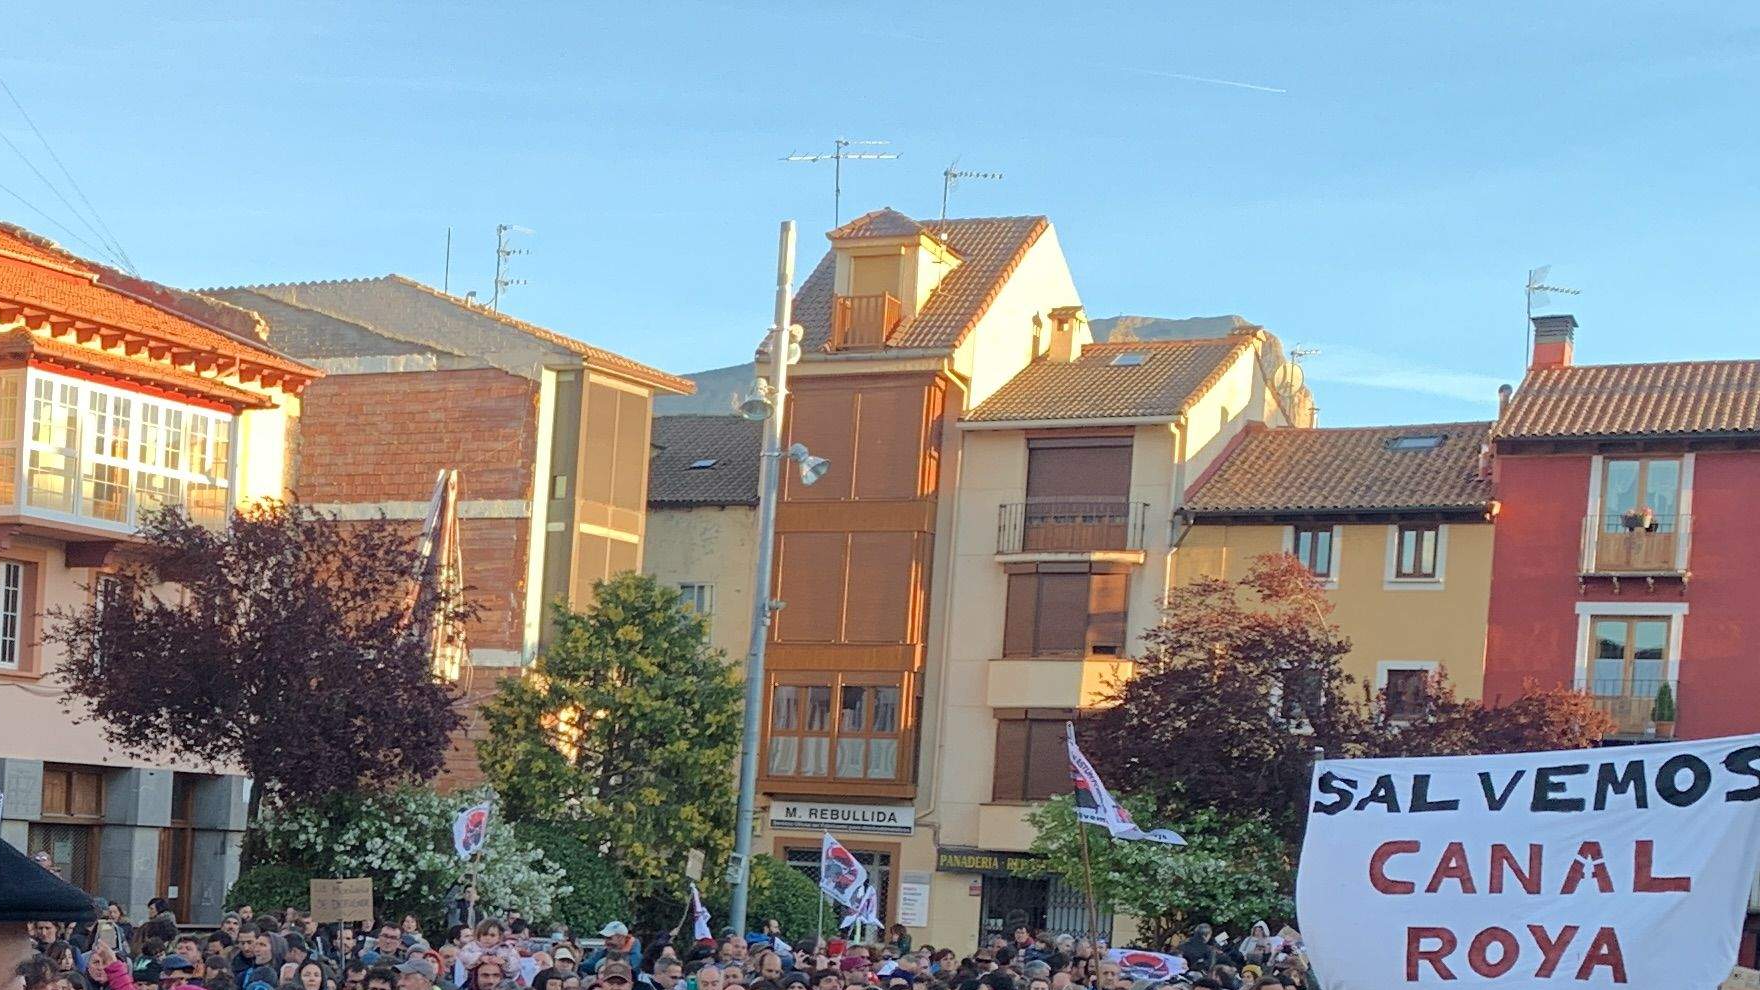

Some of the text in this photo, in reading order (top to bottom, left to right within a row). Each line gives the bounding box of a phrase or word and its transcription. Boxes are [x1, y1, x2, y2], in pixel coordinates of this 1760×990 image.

[1313, 746, 1760, 816] SALVEMOS
[785, 807, 898, 823] M. REBULLIDA
[1369, 840, 1691, 895] CANAL
[1406, 925, 1628, 984] ROYA
